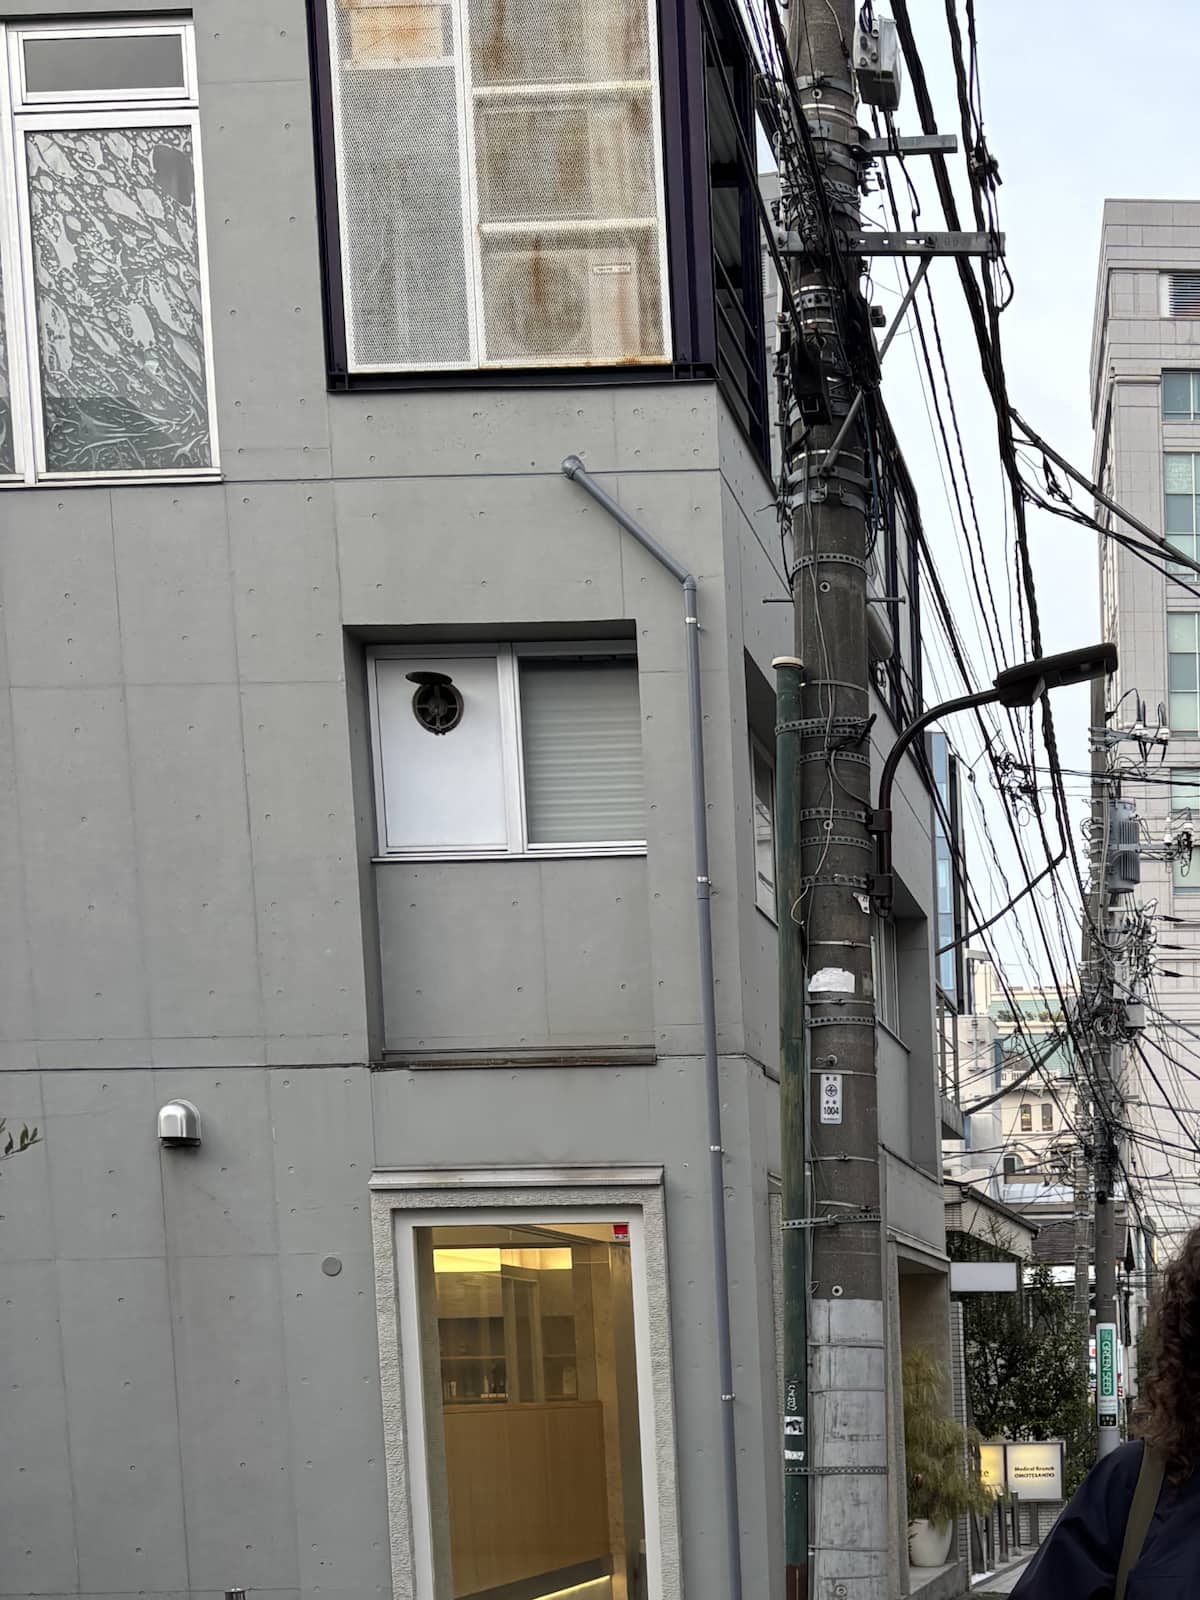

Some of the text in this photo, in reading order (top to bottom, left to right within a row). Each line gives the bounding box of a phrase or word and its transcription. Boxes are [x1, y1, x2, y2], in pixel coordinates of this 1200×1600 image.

[823, 1106, 839, 1115] 1004
[1102, 1341, 1112, 1371] GREEN
[1102, 1371, 1112, 1395] SEED
